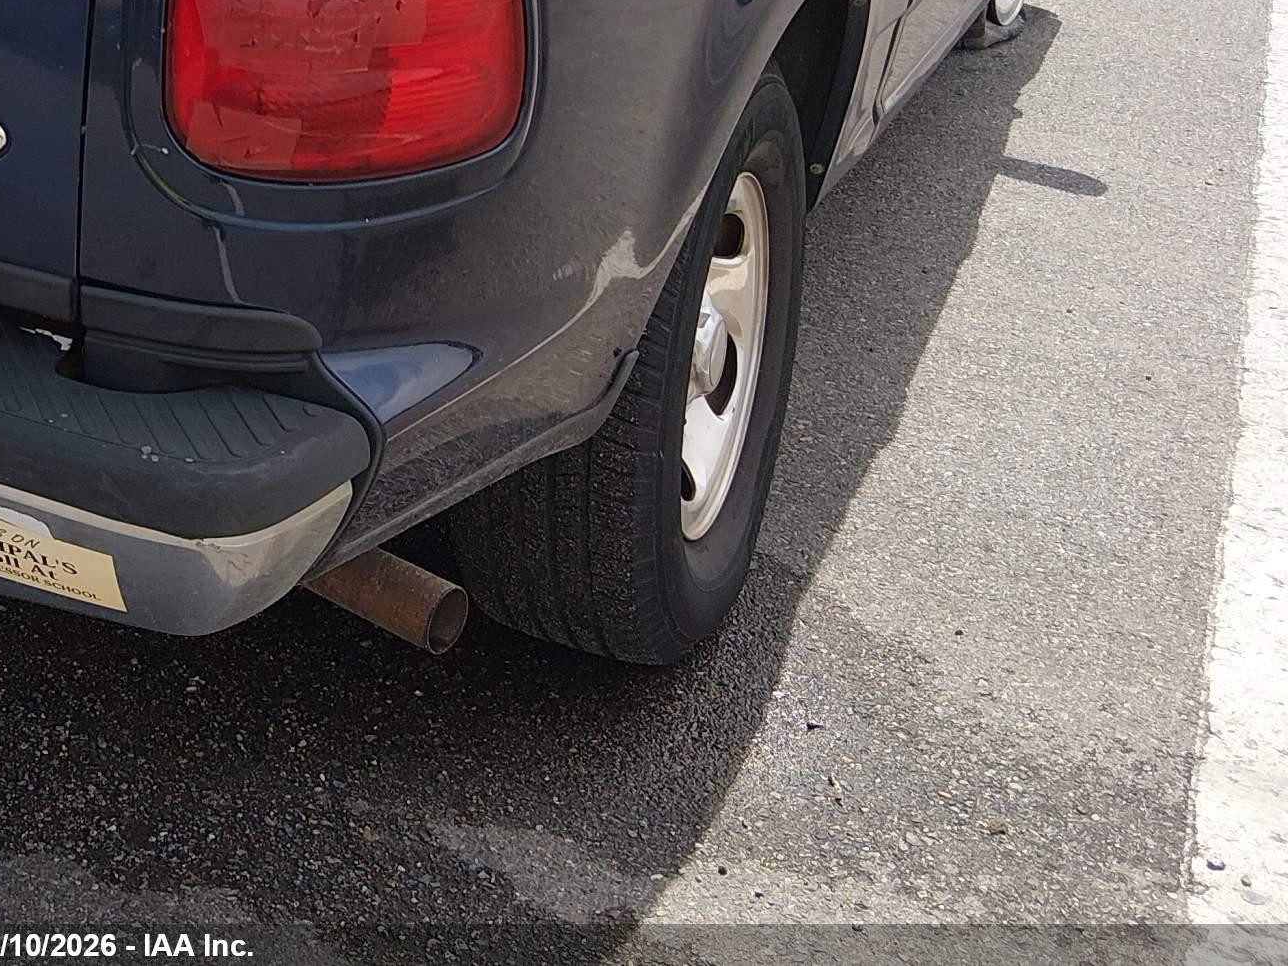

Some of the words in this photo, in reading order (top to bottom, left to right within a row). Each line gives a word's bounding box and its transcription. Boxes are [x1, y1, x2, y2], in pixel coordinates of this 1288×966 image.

[11, 534, 40, 549] ON
[31, 564, 62, 581] At
[43, 579, 101, 601] SCHOOL
